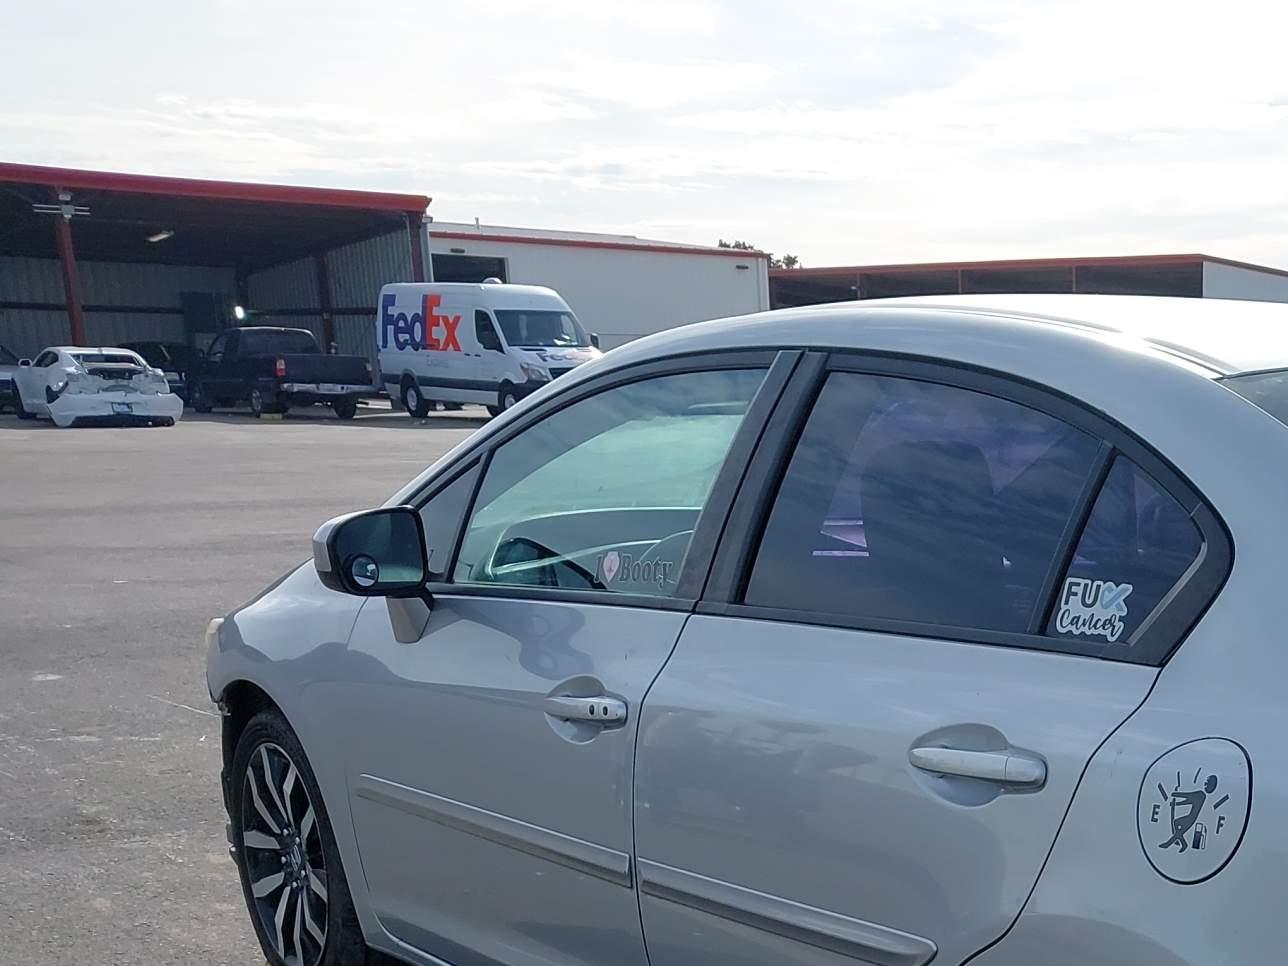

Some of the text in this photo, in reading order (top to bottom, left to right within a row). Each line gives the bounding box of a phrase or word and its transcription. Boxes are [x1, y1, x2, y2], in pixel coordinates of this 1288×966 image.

[381, 293, 462, 352] FedEx
[619, 553, 673, 591] Booty
[1059, 608, 1122, 638] Cancer
[1150, 804, 1161, 823] E
[1215, 815, 1226, 835] F
